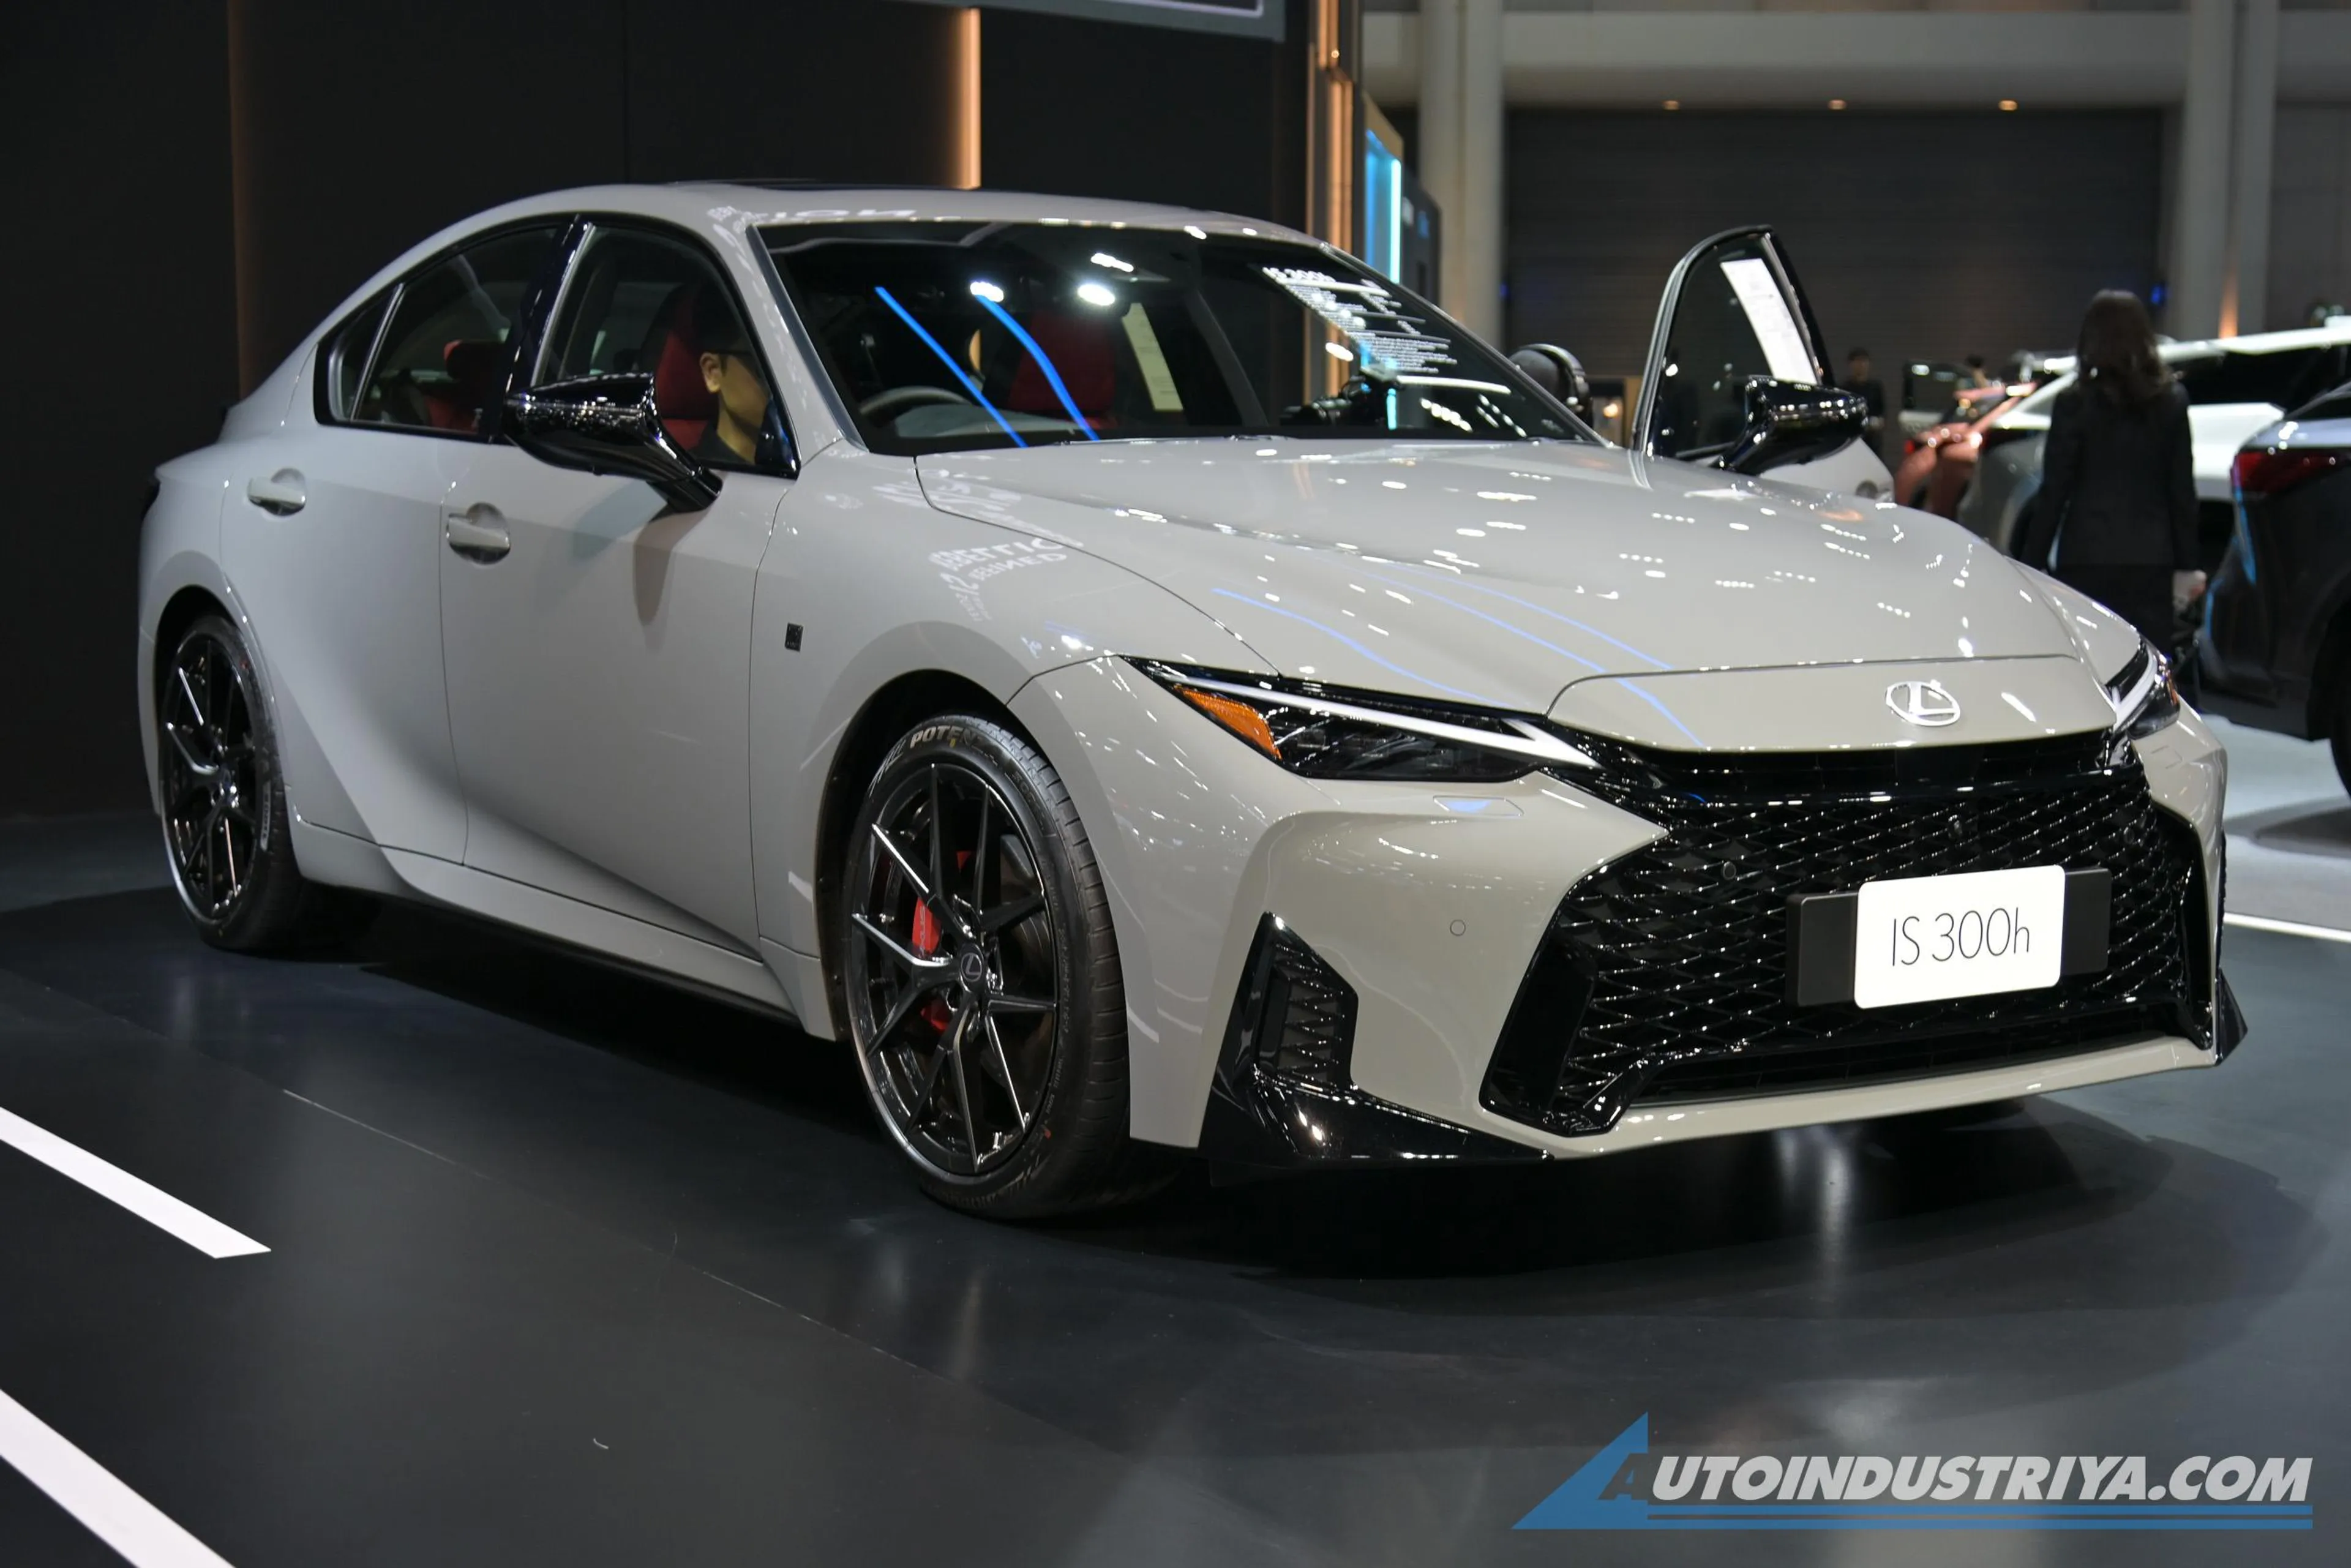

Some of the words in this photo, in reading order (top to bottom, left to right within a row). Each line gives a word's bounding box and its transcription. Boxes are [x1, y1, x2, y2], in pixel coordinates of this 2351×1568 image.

[910, 726, 986, 752] POTEN
[1892, 916, 1921, 967] IS
[1932, 907, 2030, 962] 300h
